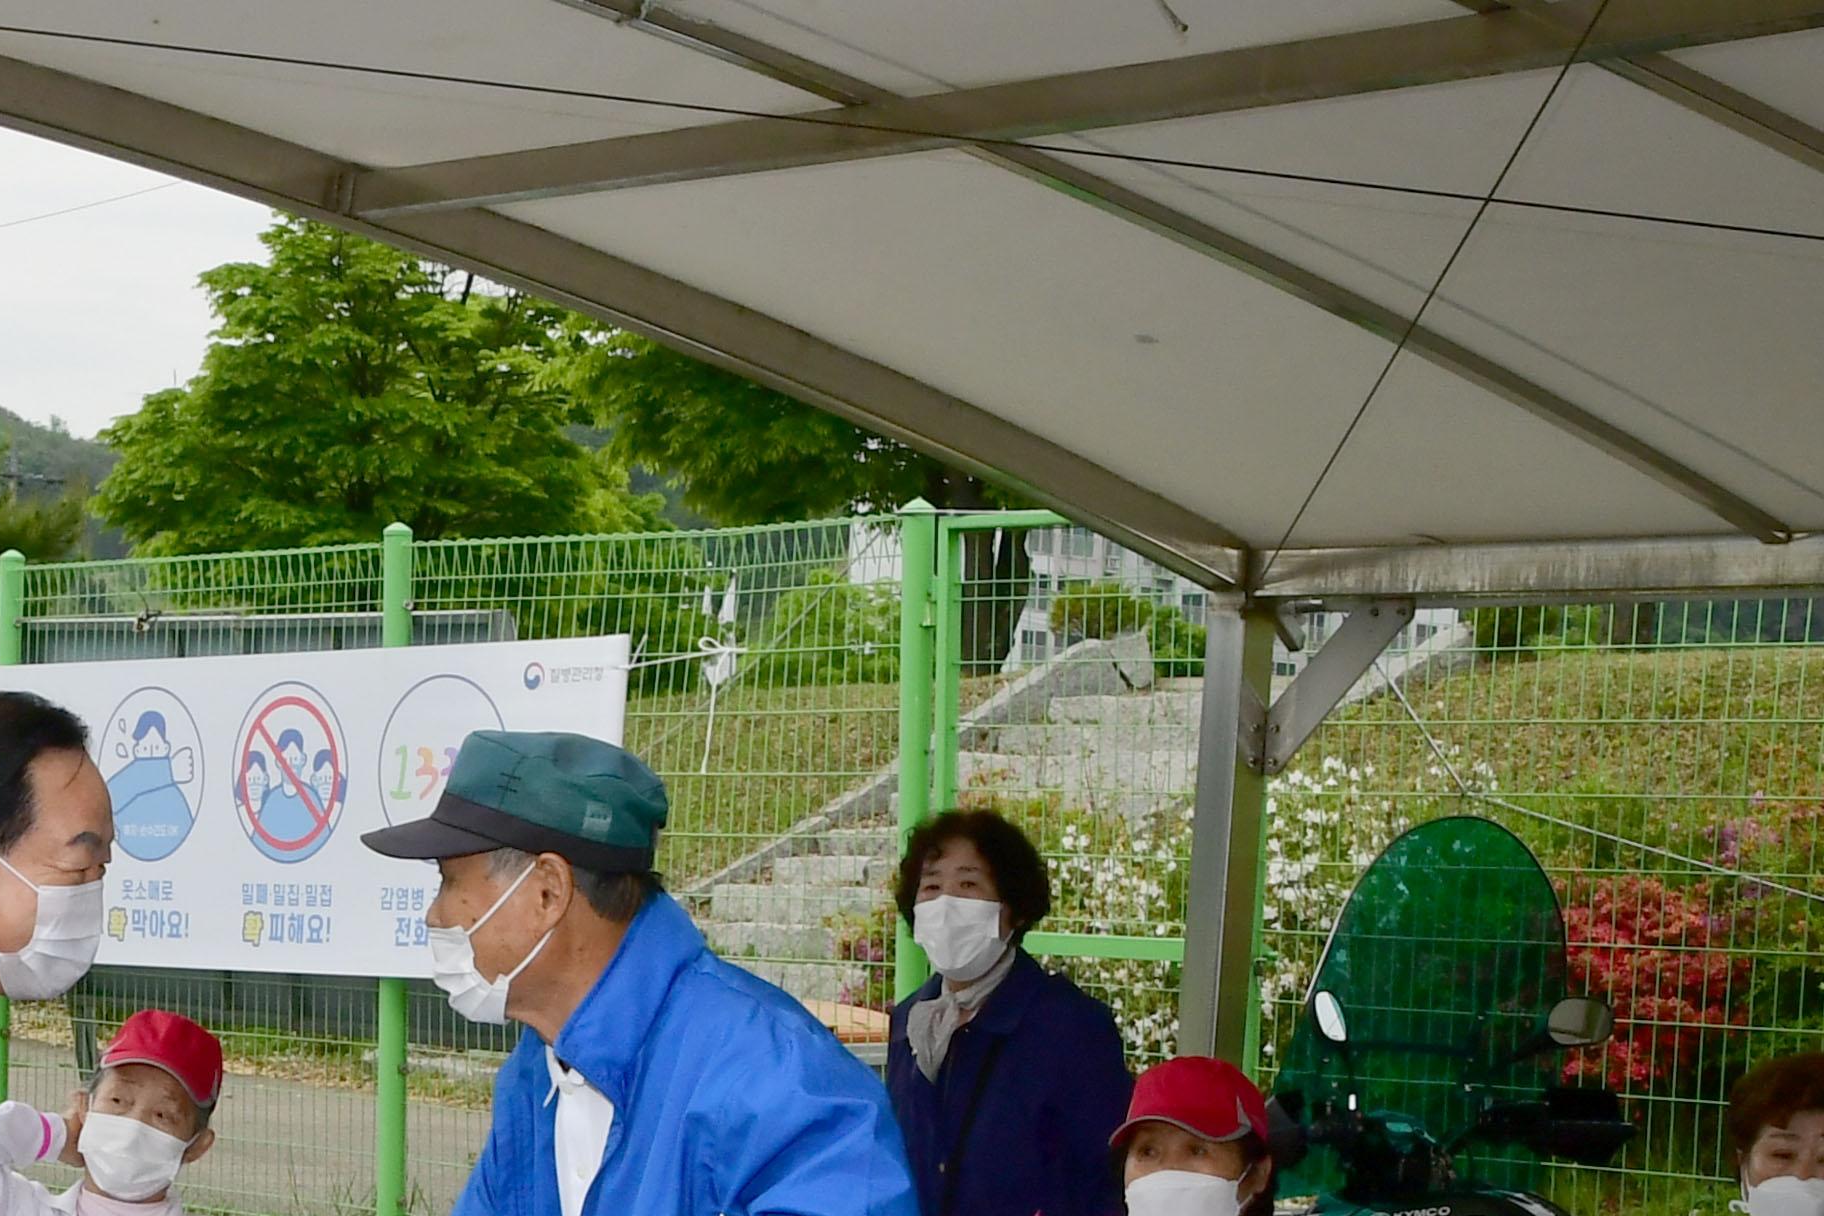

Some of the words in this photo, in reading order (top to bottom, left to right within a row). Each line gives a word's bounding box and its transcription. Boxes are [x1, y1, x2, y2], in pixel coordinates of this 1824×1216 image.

[121, 879, 174, 901] 옷소매로
[380, 887, 425, 911] 감염병
[131, 908, 189, 939] 막아요!
[269, 912, 331, 944] 피해요!
